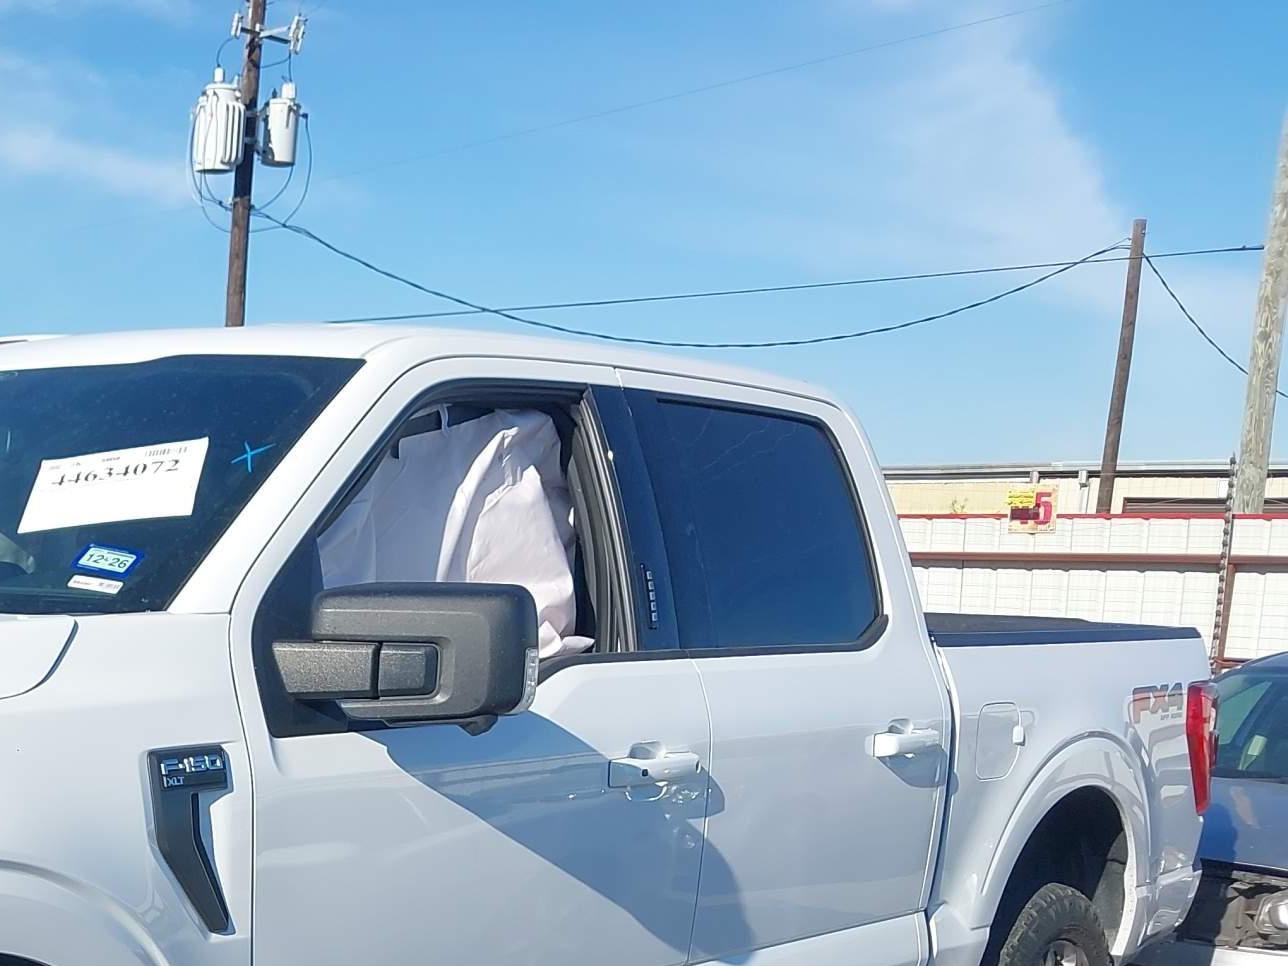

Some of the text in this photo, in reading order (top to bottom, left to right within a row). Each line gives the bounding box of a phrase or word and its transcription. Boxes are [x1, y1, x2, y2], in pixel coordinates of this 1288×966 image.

[51, 458, 181, 487] 44634072
[1132, 682, 1183, 725] FX4
[166, 776, 185, 787] XLT
